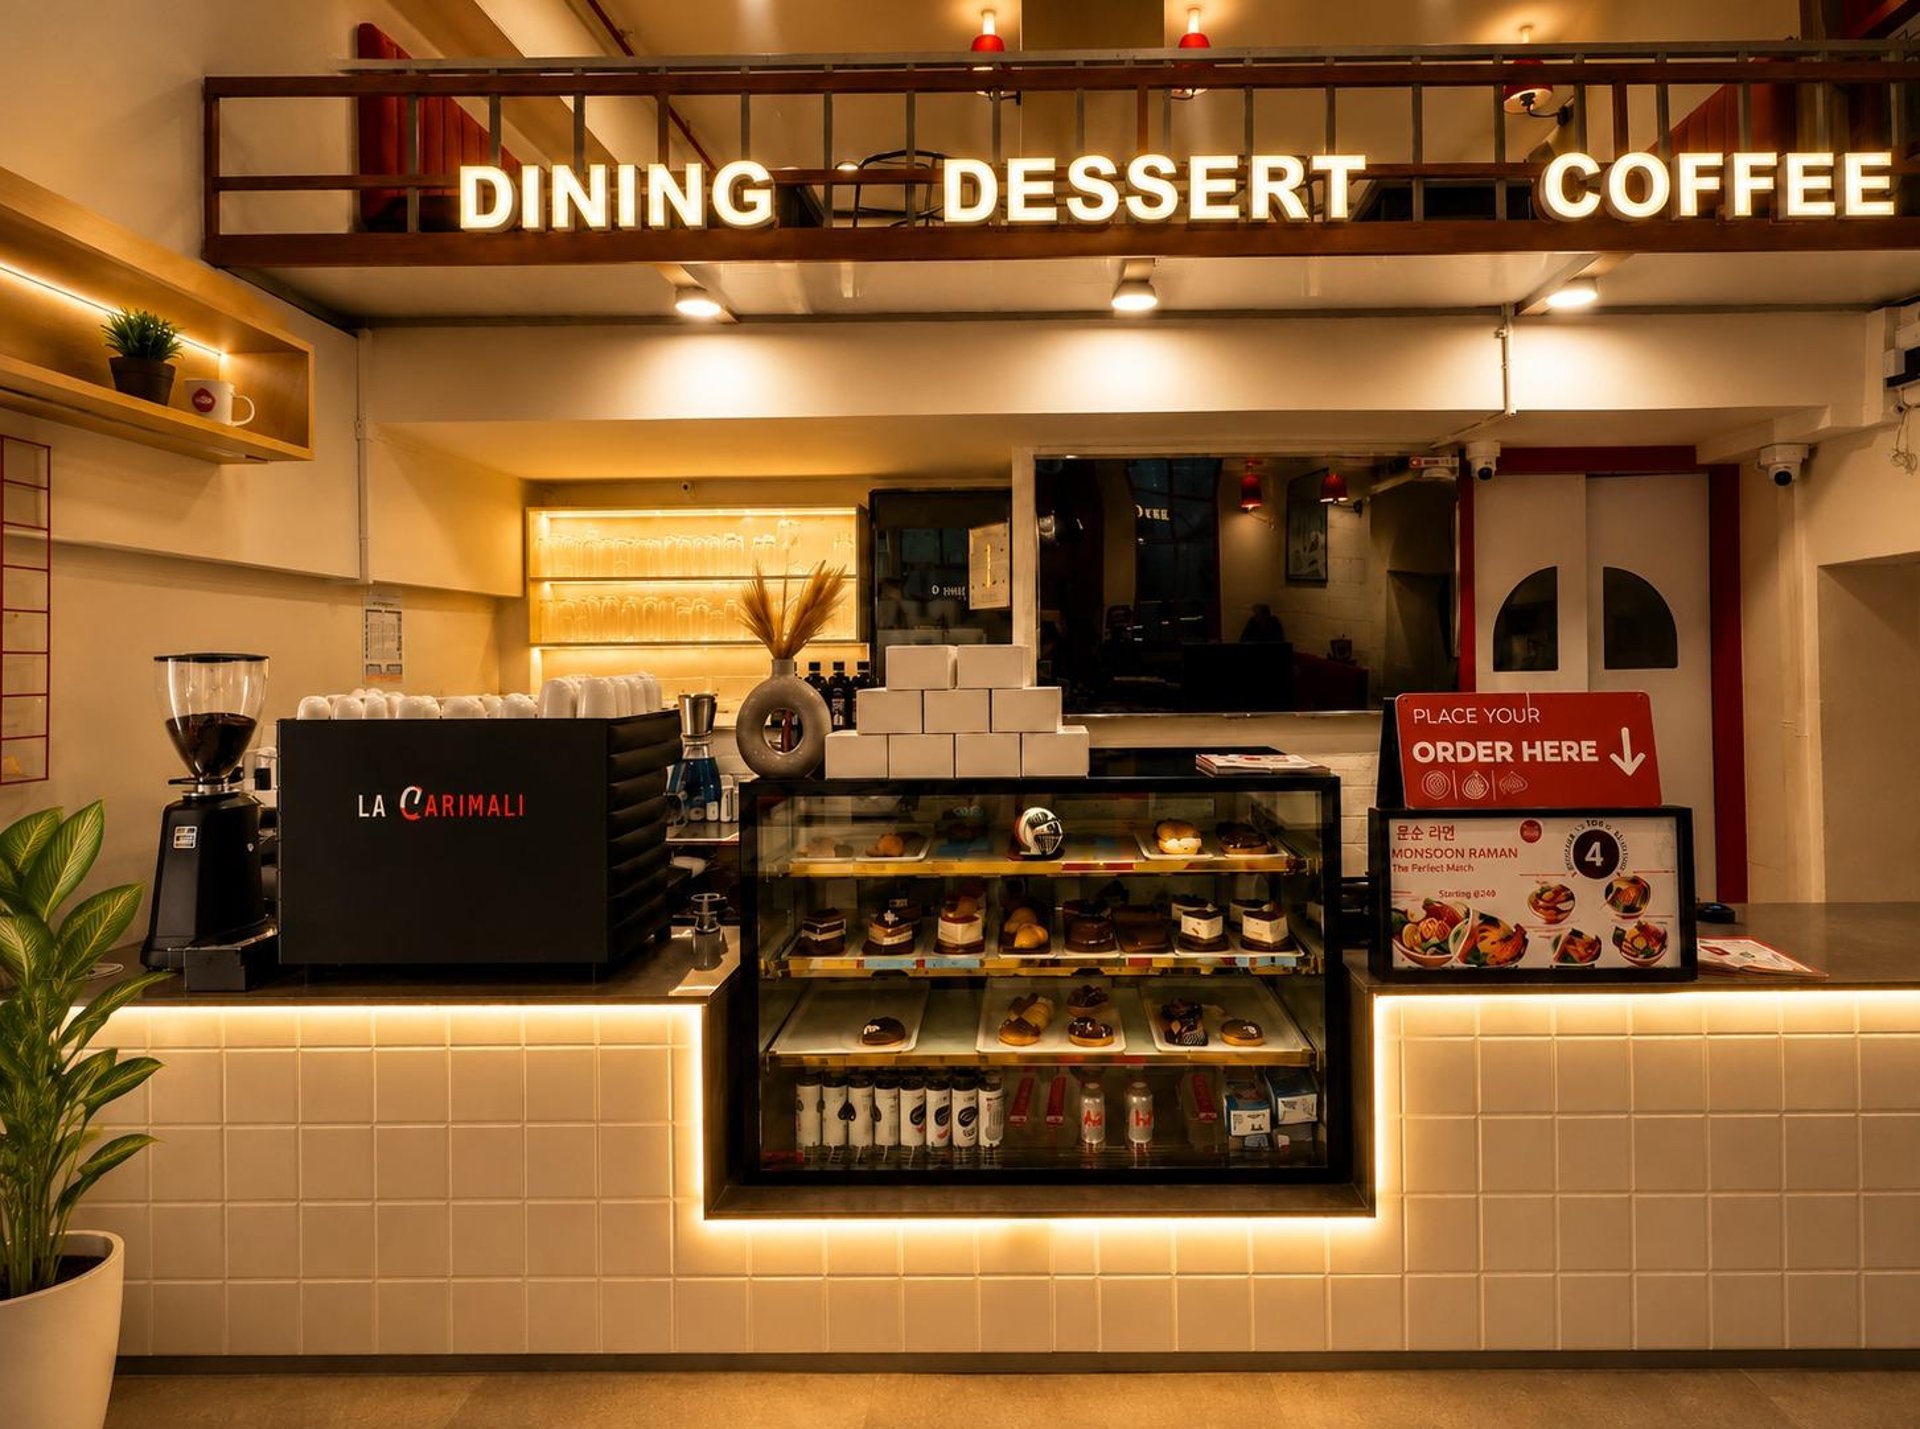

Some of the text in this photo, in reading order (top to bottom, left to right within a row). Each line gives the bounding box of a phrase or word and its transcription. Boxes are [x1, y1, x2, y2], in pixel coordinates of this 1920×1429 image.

[459, 151, 1896, 231] DINING DESSERT COFFEE
[1413, 707, 1541, 724] PLACE YOUR
[1412, 740, 1599, 764] ORDER HERE
[357, 785, 524, 821] LA CARIMALI
[1391, 847, 1518, 859] MONSOON RAMAN
[1585, 841, 1604, 867] 4
[1392, 863, 1474, 873] The Perfect Match
[1438, 889, 1472, 900] Starting
